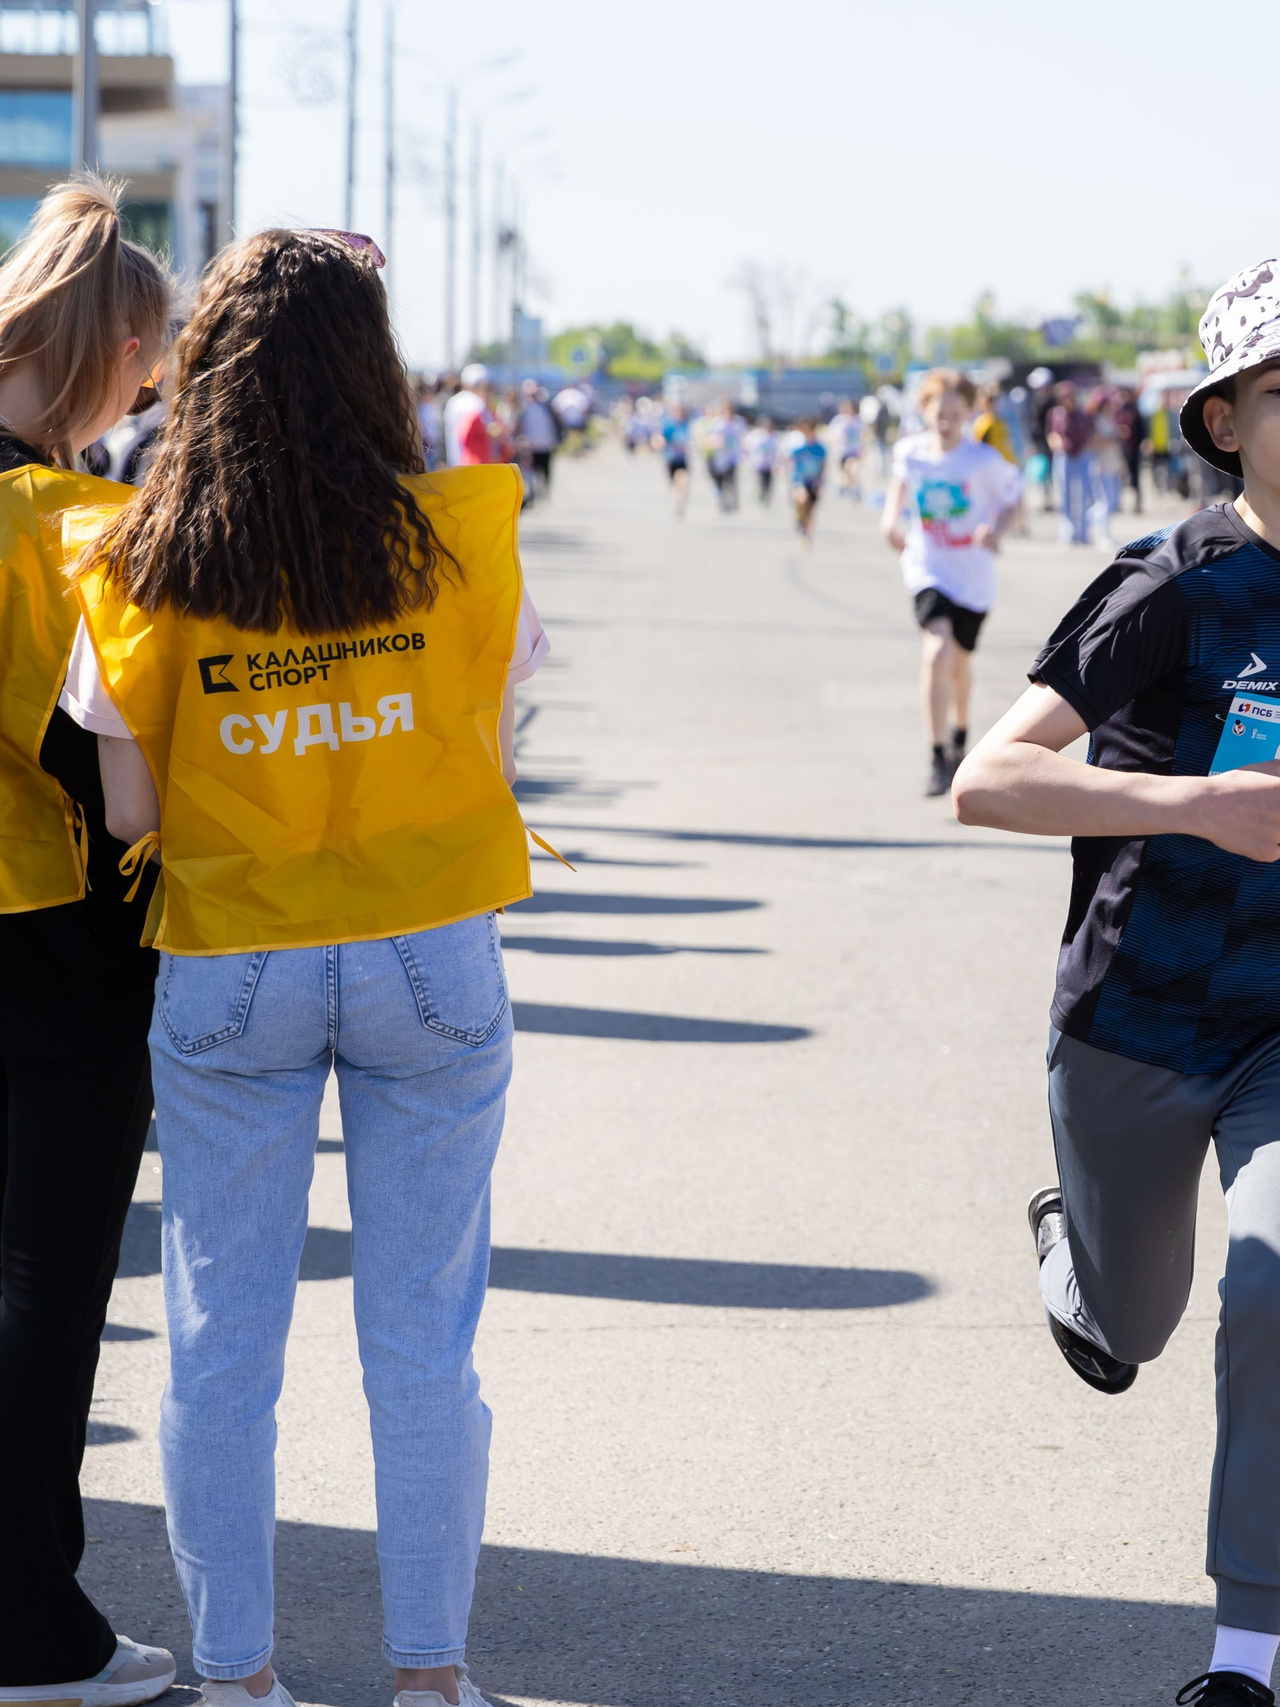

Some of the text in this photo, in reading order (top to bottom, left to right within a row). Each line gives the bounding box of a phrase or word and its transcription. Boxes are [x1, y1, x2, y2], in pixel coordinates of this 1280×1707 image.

[246, 632, 426, 672] КАЛАШНИКОВ
[249, 664, 331, 691] СПОРТ
[1221, 680, 1279, 691] DEMIX
[219, 692, 415, 756] СУДЬЯ
[1251, 706, 1273, 718] ПСБ
